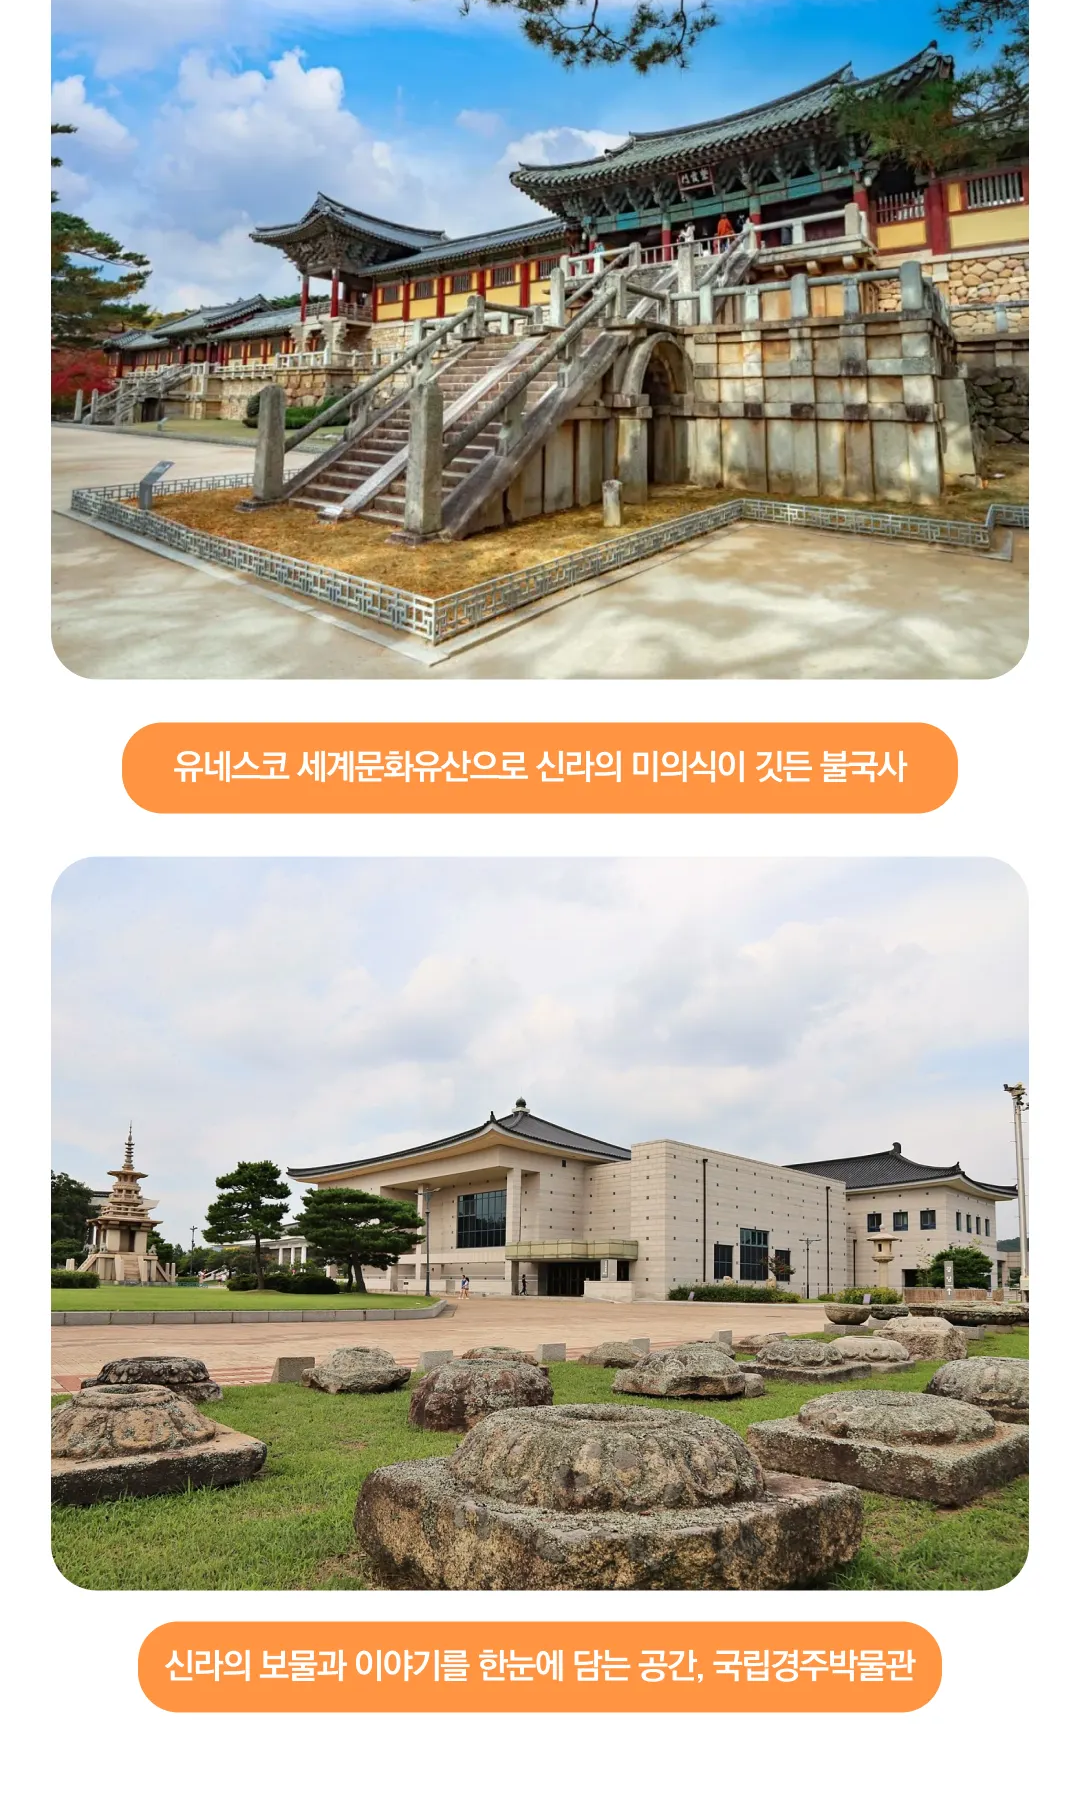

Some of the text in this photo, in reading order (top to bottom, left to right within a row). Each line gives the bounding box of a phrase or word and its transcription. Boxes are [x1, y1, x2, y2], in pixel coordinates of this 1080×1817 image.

[174, 750, 908, 783] 유네스코 세계문화유산으로 신라의 미의식이 깃든 불국사
[165, 1650, 916, 1683] 신라의 보물과 이야기를 한눈에 담는 공간, 국립경주박물관
